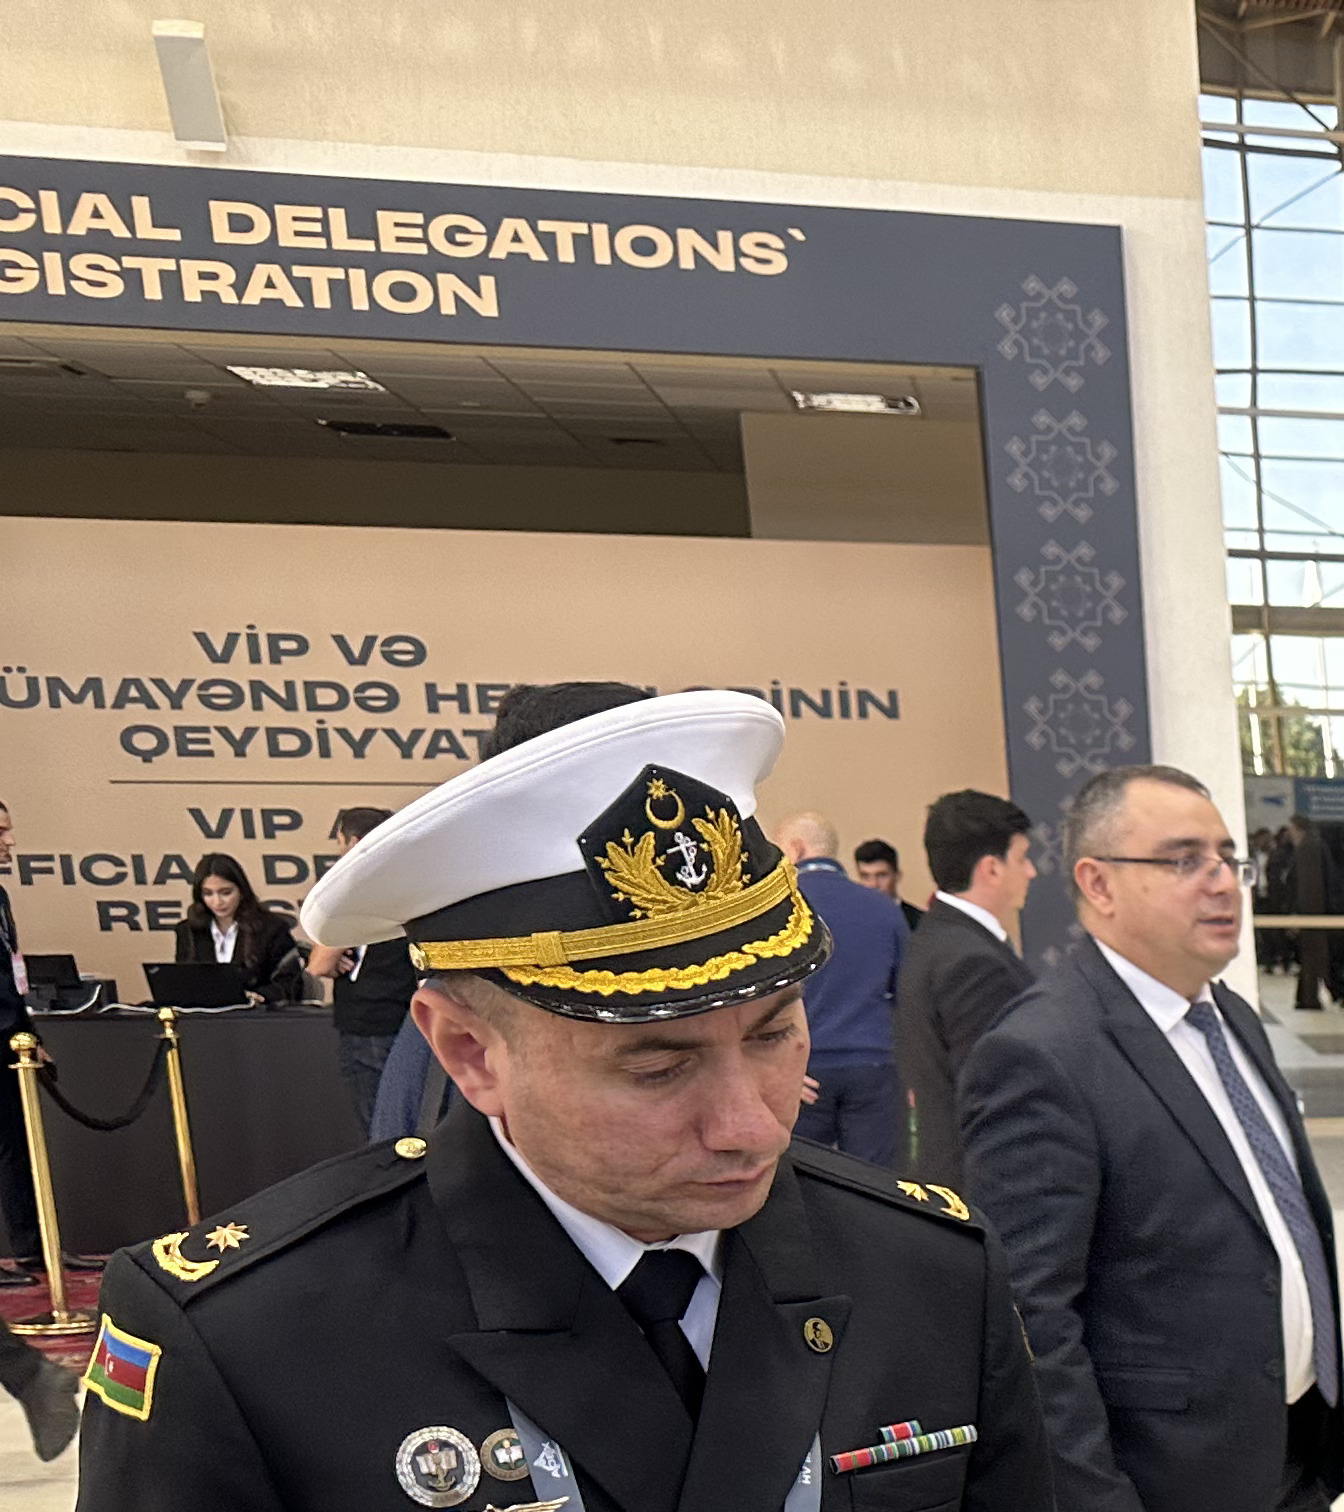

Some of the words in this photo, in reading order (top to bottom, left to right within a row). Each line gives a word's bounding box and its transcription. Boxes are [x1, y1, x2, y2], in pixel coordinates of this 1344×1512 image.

[192, 624, 310, 665] VİP
[330, 633, 428, 667] VƏ
[0, 665, 400, 712] ÜMAYƏNDƏ
[187, 808, 304, 840] VIP
